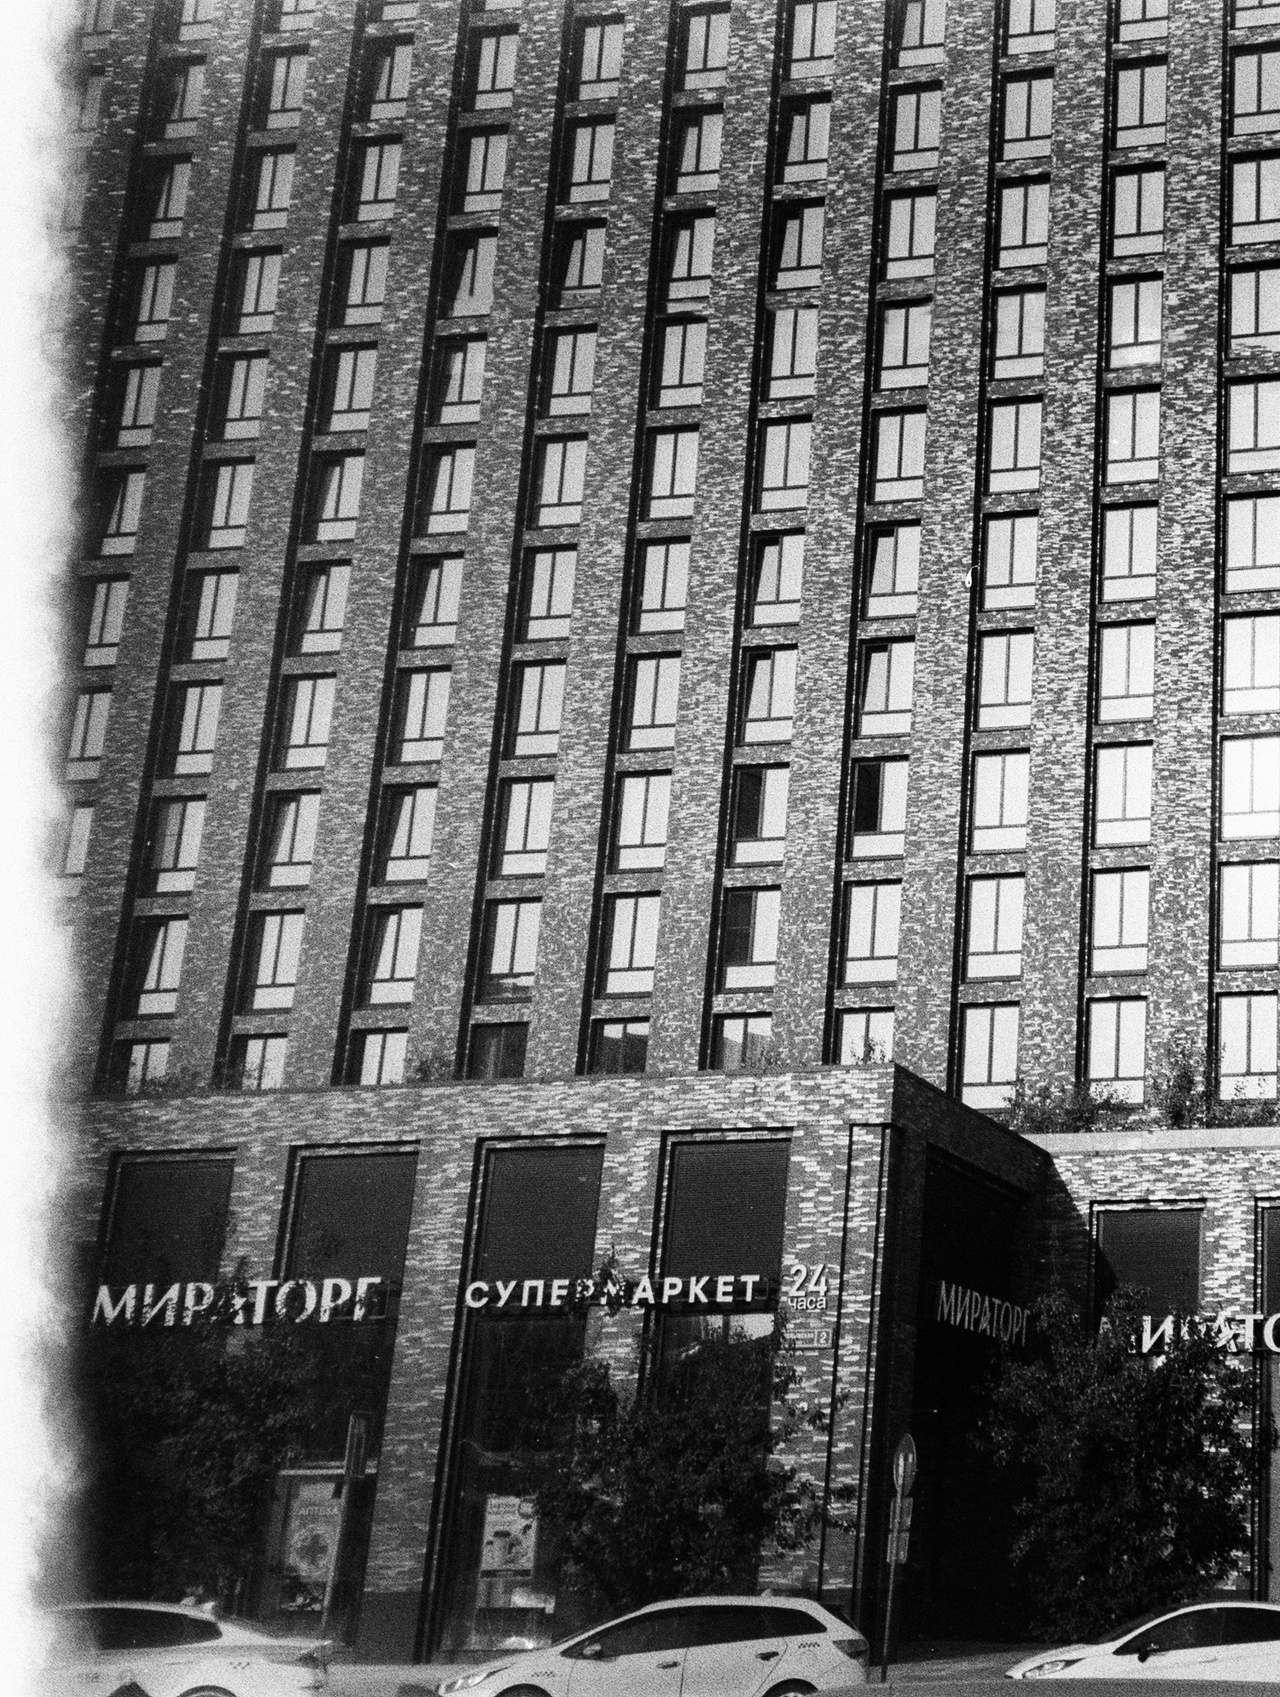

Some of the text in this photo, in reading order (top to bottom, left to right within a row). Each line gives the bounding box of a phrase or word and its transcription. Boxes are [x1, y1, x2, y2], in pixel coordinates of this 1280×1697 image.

[465, 1274, 760, 1309] СУПЕРМАРКЕТ
[788, 1264, 827, 1297] 24
[788, 1296, 827, 1310] часа
[937, 1280, 1032, 1347] МИРАТОРГ
[819, 1332, 828, 1344] 2
